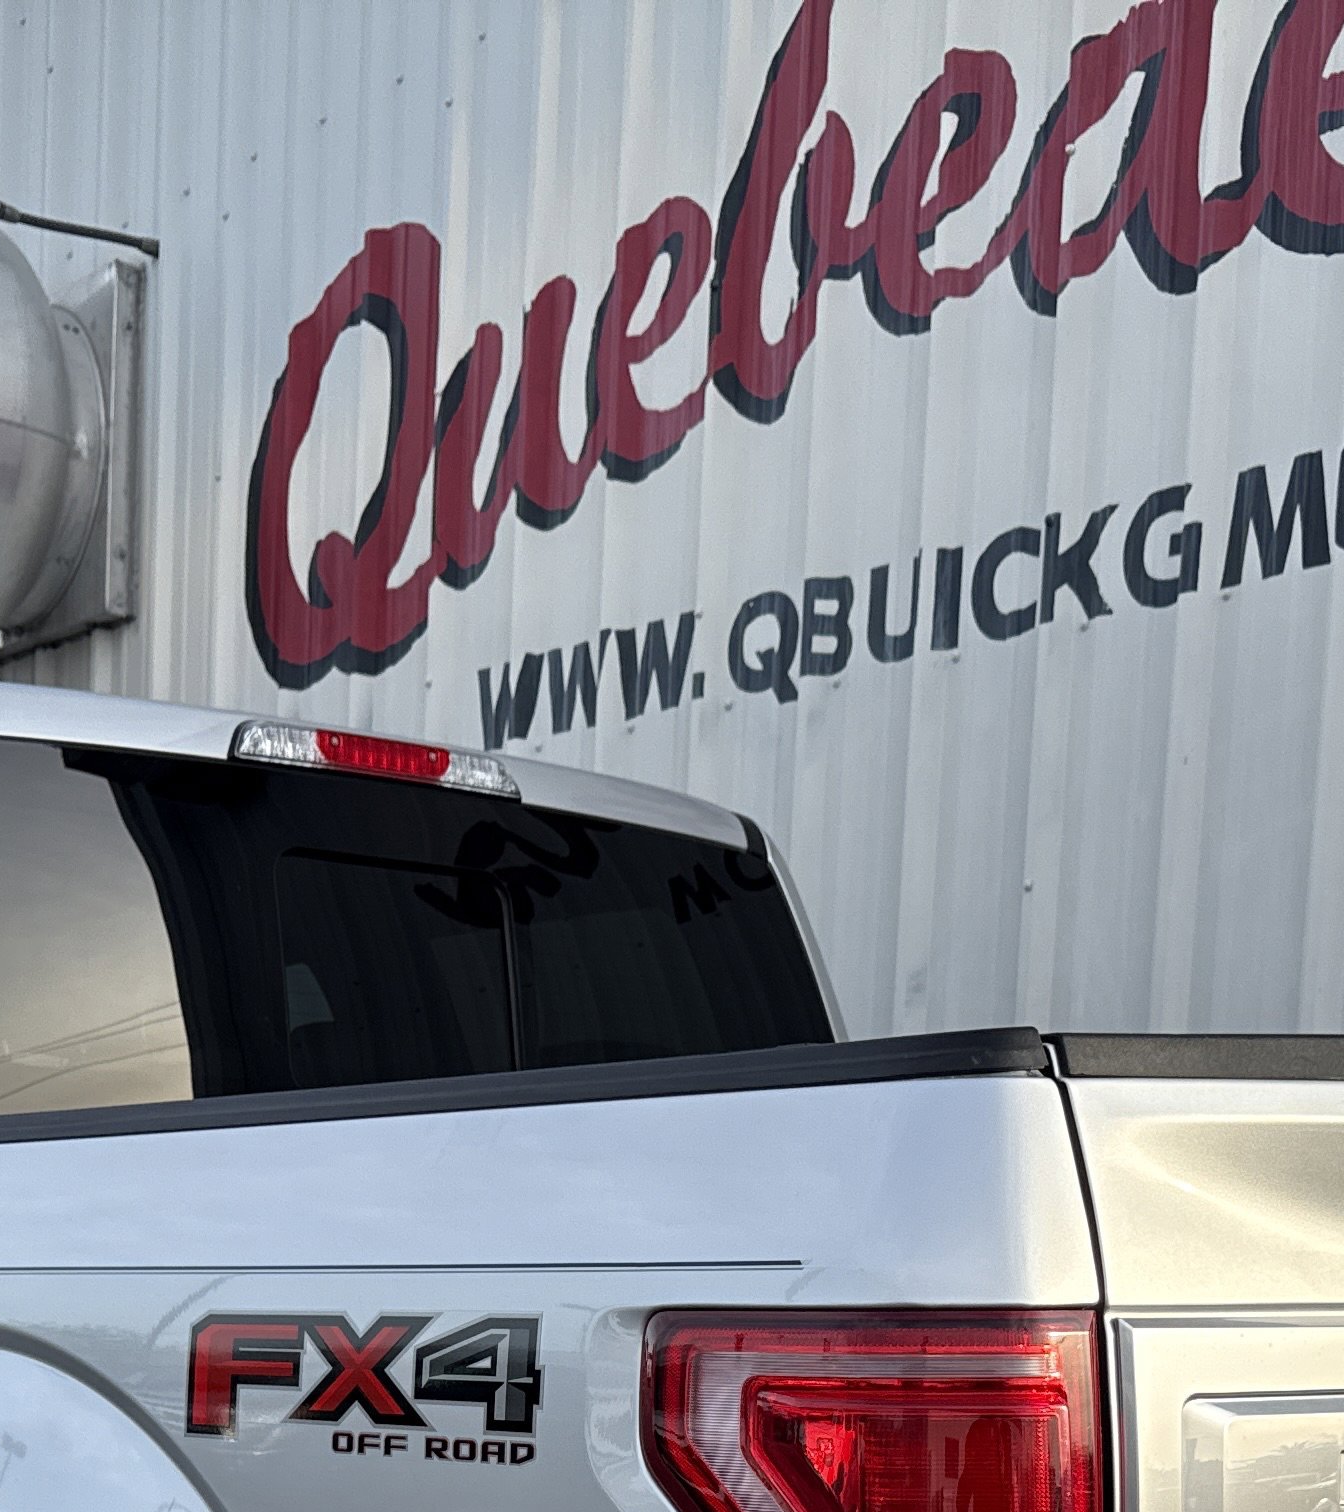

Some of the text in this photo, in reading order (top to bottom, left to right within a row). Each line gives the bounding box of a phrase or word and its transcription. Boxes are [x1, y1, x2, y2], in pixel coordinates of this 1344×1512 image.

[184, 1311, 545, 1441] FX4
[331, 1431, 537, 1467] OFF ROAD
